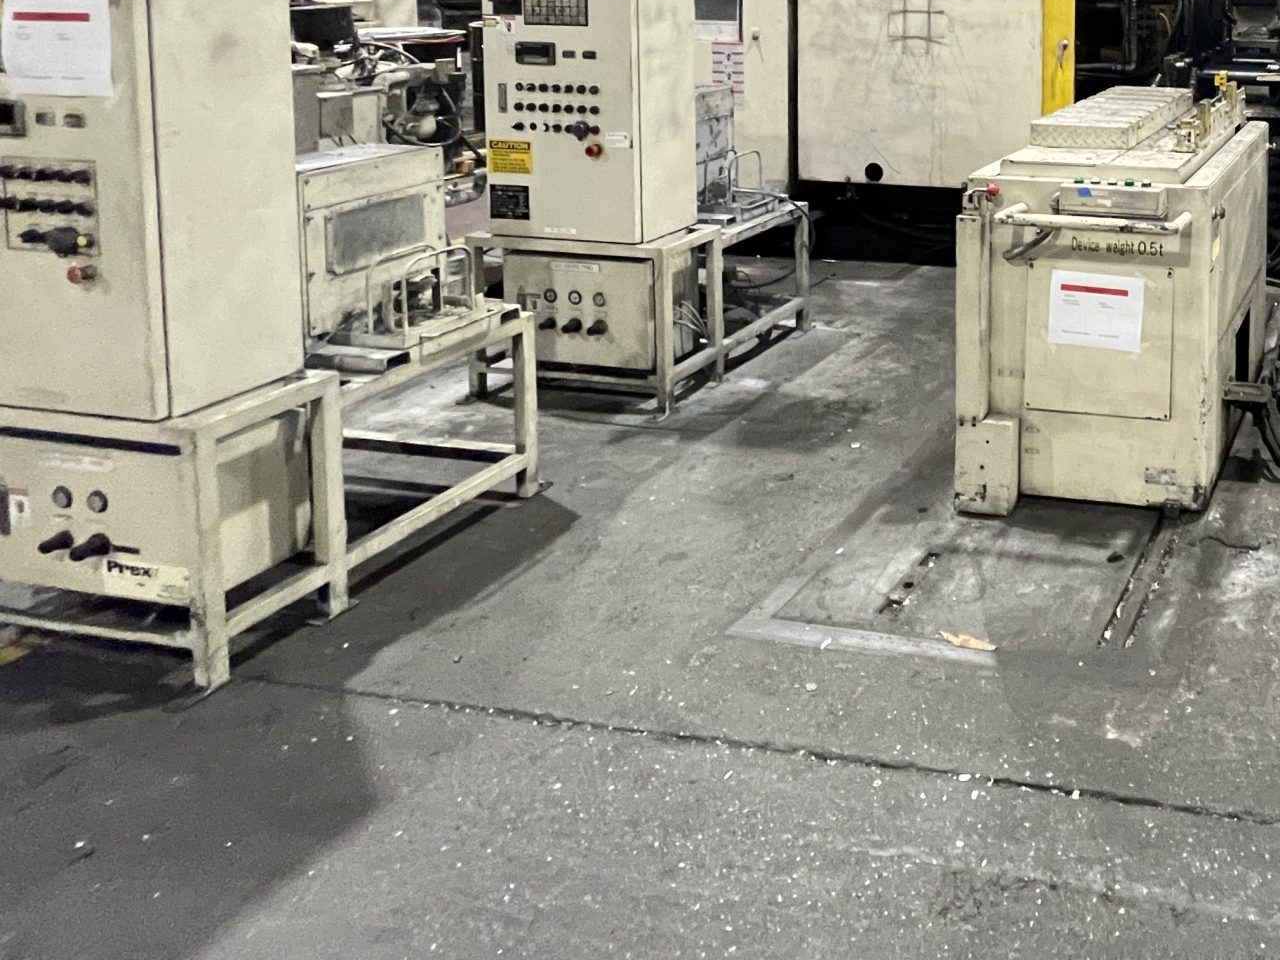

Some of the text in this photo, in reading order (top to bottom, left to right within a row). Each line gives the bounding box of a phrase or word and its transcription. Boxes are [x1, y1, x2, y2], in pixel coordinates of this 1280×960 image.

[491, 141, 529, 149] CAUTION
[1071, 236, 1164, 257] Device weight 0.5t
